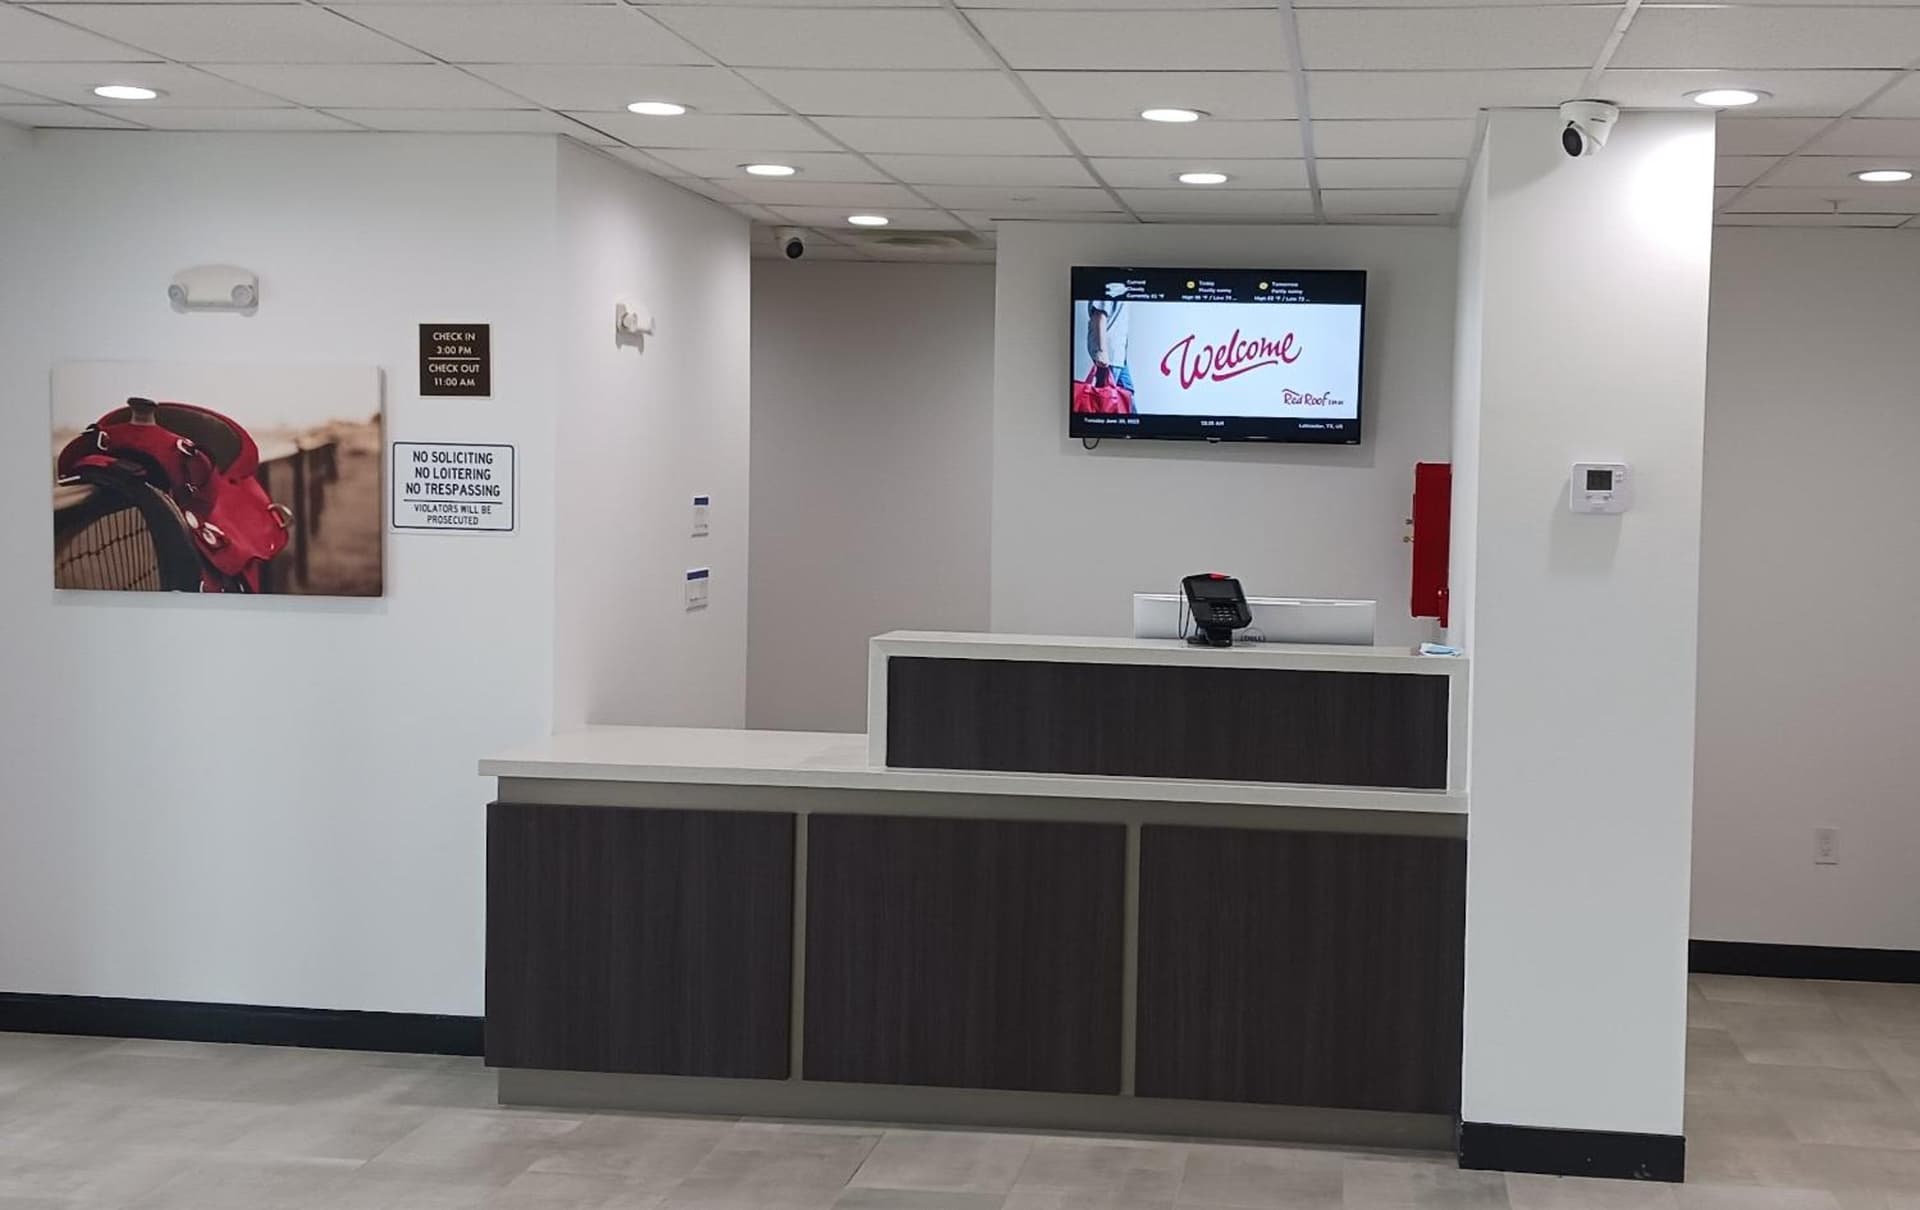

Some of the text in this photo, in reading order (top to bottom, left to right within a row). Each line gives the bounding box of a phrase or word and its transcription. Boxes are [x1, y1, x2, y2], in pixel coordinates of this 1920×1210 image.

[432, 332, 476, 341] CHECK IN
[437, 345, 472, 354] 3:00 PM
[1160, 328, 1302, 389] Welcome
[428, 363, 480, 373] CHECK OUT
[434, 377, 476, 386] 11:00 AM
[1282, 390, 1303, 405] Red
[1304, 391, 1330, 406] Roof
[413, 450, 493, 464] NO SOLICITING
[415, 466, 491, 480] NO LOITERING
[405, 482, 501, 497] NO TRESPASSING
[414, 504, 492, 515] VIOLATORS WILL BE
[427, 515, 479, 525] PROSECUTED
